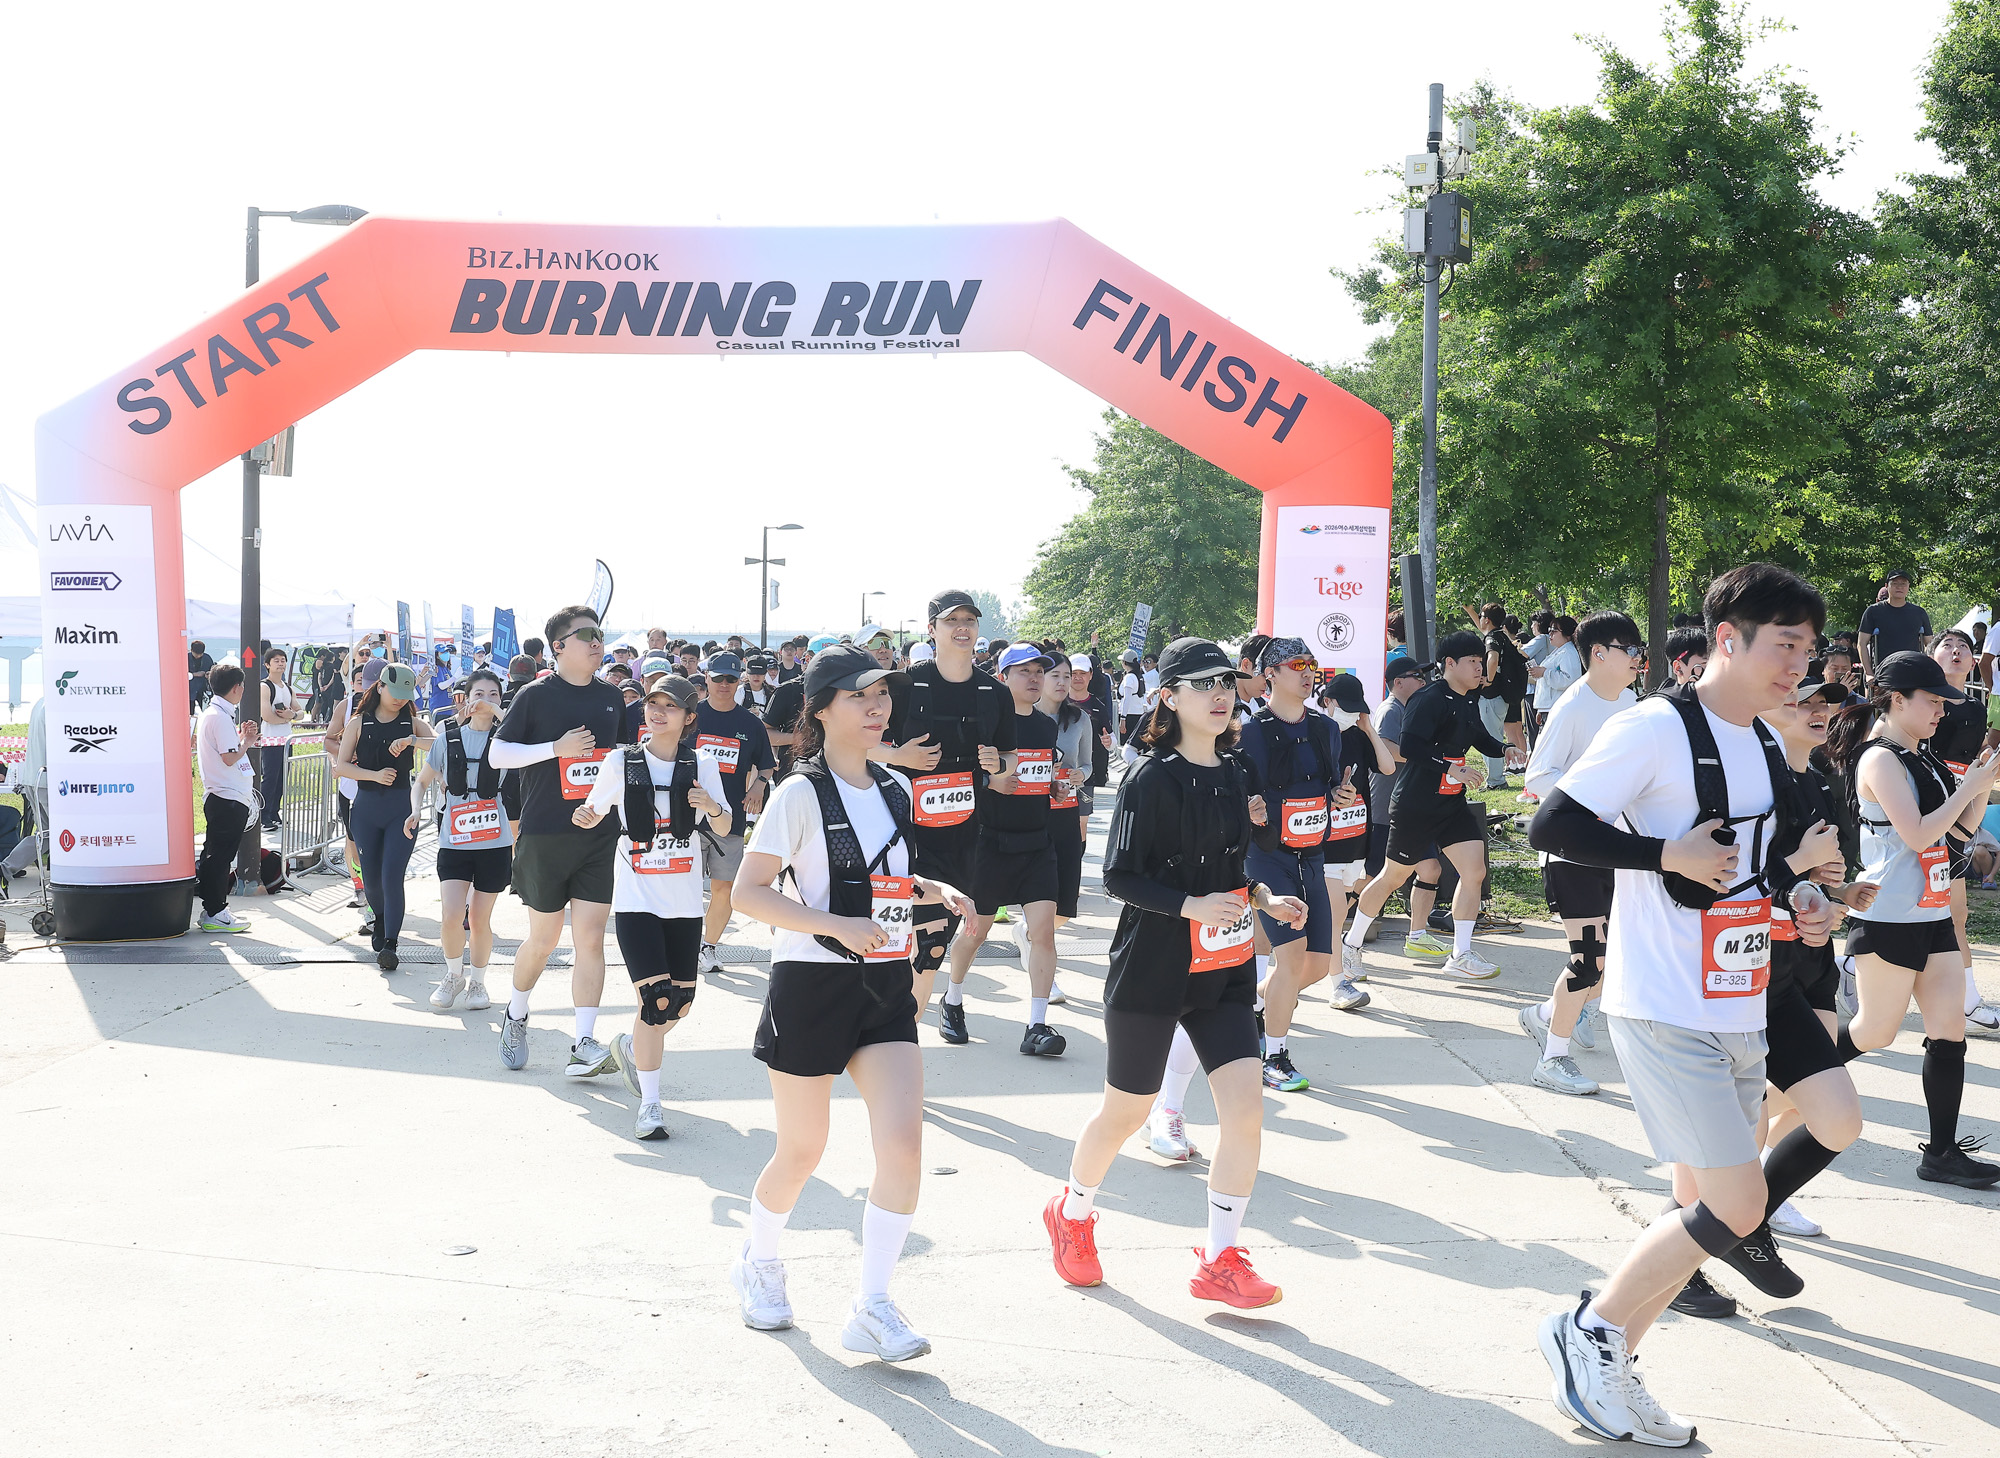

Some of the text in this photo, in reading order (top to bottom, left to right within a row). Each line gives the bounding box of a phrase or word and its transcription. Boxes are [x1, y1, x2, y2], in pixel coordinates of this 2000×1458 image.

[450, 279, 982, 337] BURNING RUN
[716, 339, 960, 351] Casual Running Festival
[117, 272, 340, 434] START
[1072, 279, 1308, 443] FINISH
[54, 576, 109, 587] FAVONEX
[1314, 577, 1363, 600] Tage
[1322, 615, 1351, 626] SUNBODY
[1325, 641, 1348, 649] TANNING
[70, 686, 127, 696] NEWTREE
[64, 725, 118, 736] Reebok
[713, 748, 738, 758] 1847
[572, 766, 600, 777] M 20
[926, 791, 973, 805] M 1406
[469, 813, 498, 825] 4119
[1342, 808, 1366, 820] 3742
[80, 835, 137, 847] 롯데웰푸드
[657, 838, 690, 850] 3756
[1933, 872, 1939, 881] W
[886, 882, 901, 890] RUN
[1706, 905, 1762, 916] BURNING RUN
[1207, 926, 1218, 938] W
[1724, 941, 1739, 954] M
[1714, 975, 1747, 986] B-325
